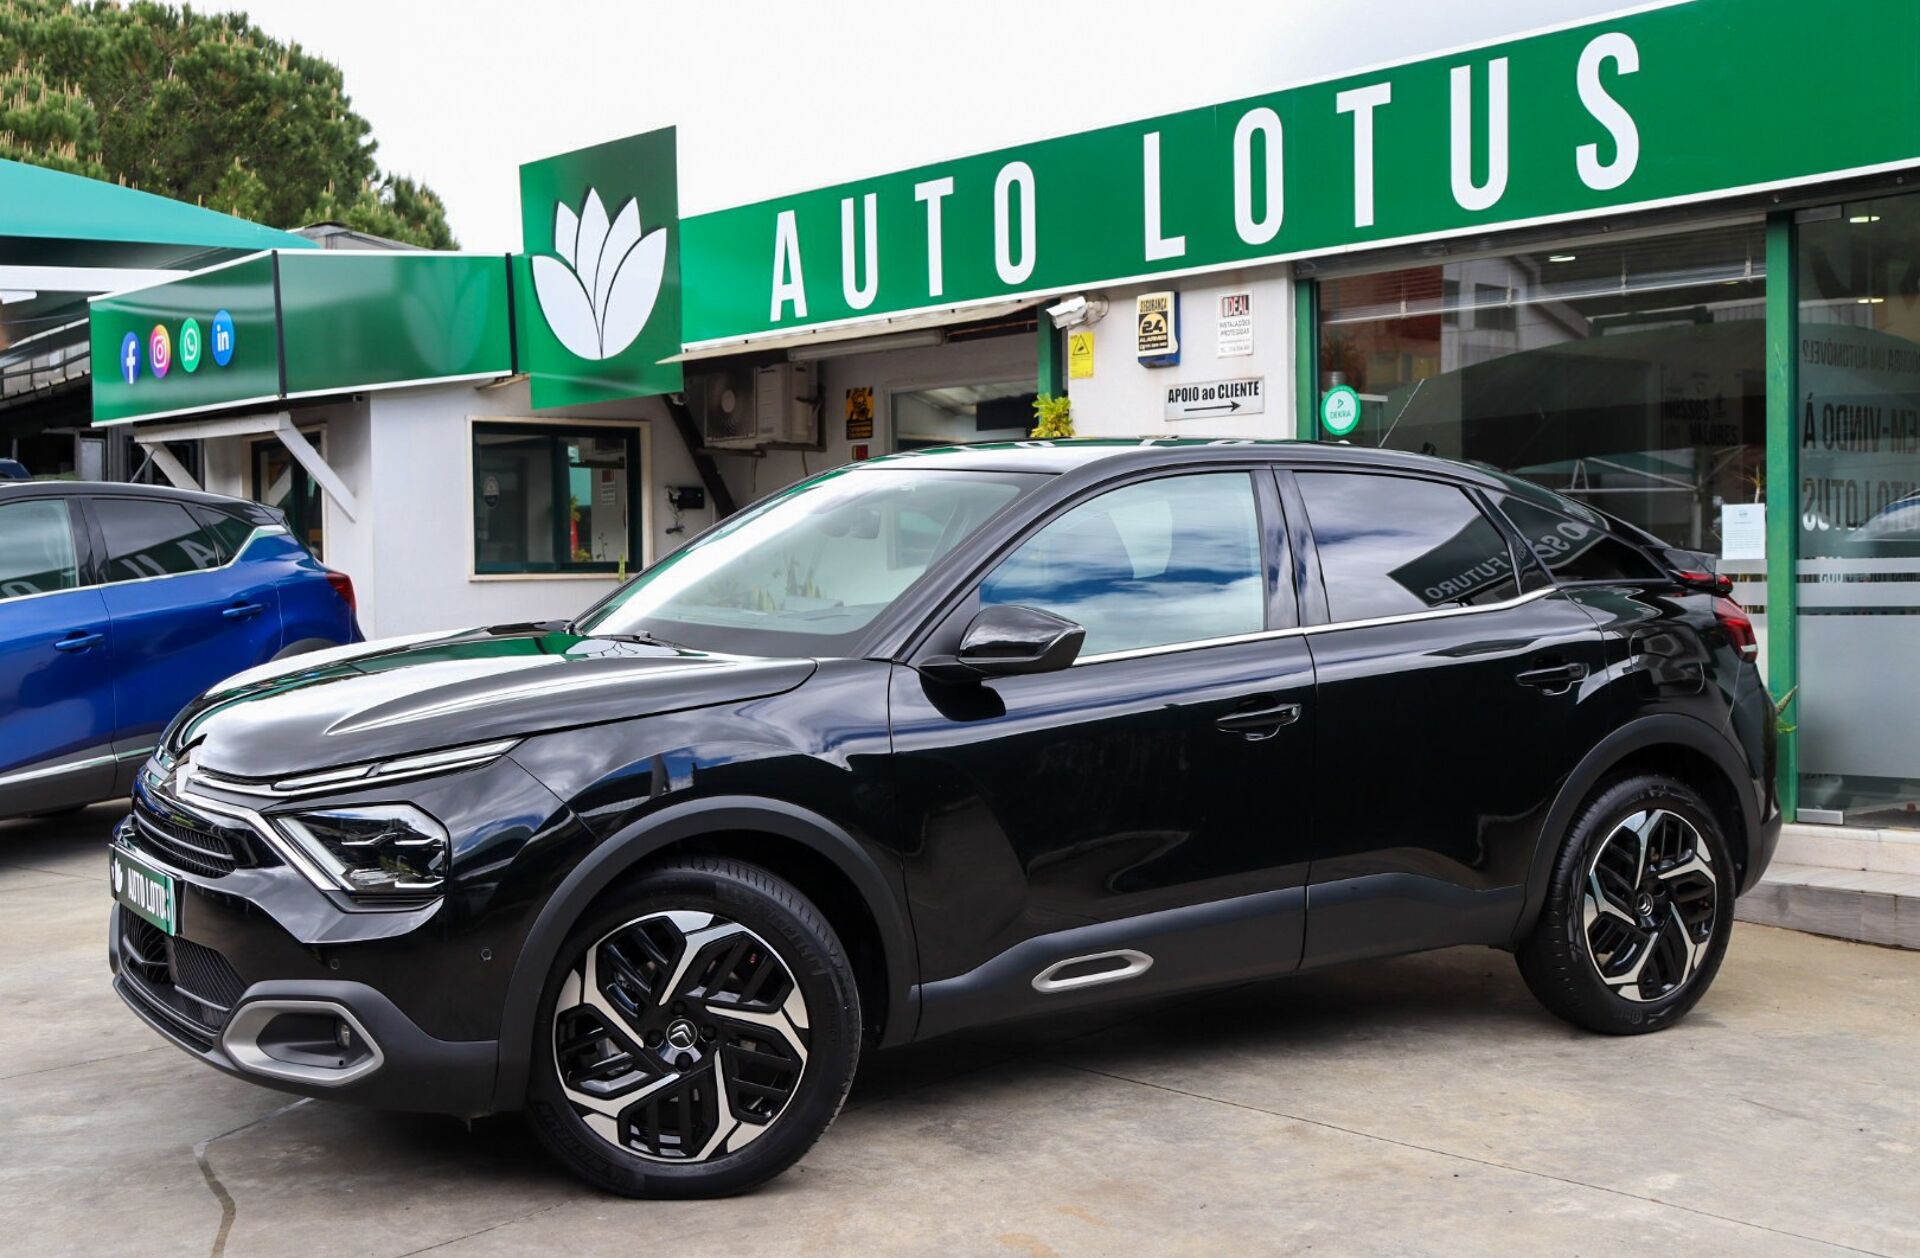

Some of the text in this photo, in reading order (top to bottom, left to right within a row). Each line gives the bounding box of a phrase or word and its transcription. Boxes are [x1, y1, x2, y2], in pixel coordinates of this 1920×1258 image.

[769, 32, 1640, 322] AUTO LOTUS
[1142, 320, 1163, 334] 24
[1168, 381, 1259, 403] APOIO ao CLIENTE
